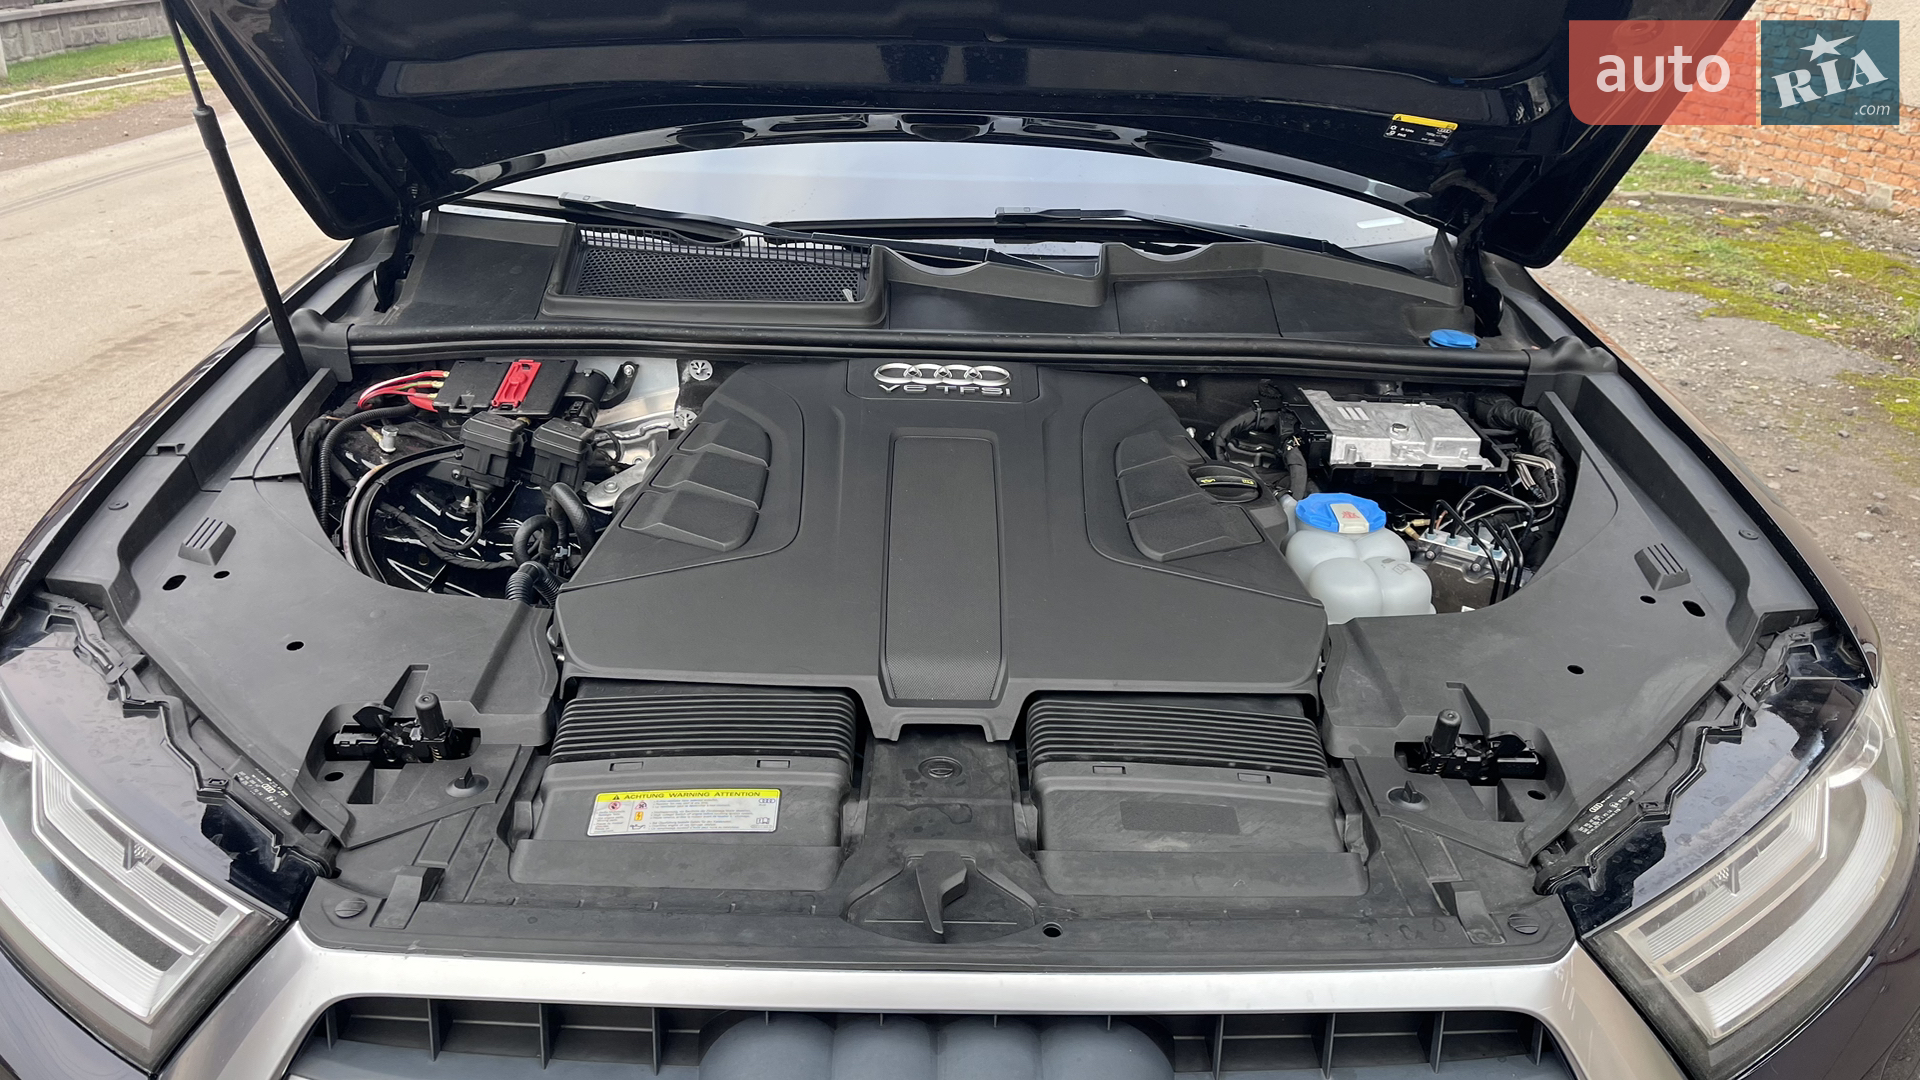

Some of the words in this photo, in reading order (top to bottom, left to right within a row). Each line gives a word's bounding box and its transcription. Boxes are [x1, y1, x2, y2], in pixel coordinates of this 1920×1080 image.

[878, 384, 927, 394] V6
[935, 385, 1012, 397] TFSI
[624, 792, 665, 800] ACHTUNG
